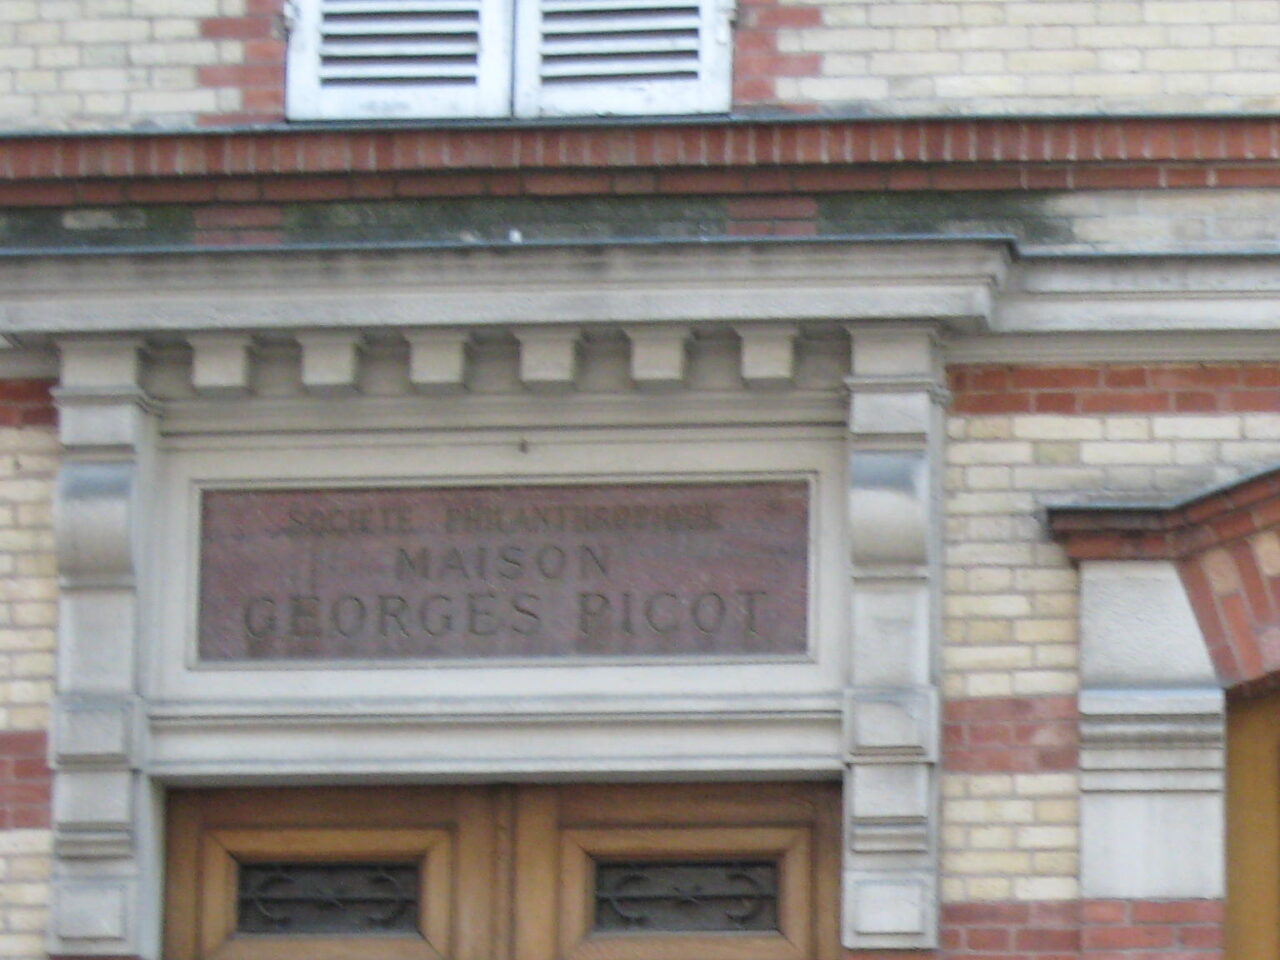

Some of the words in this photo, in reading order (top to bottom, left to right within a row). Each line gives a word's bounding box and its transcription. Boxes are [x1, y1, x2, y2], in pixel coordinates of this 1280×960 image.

[396, 544, 608, 581] MAISON
[243, 592, 541, 639] GEORGES
[577, 590, 768, 636] PICOT
